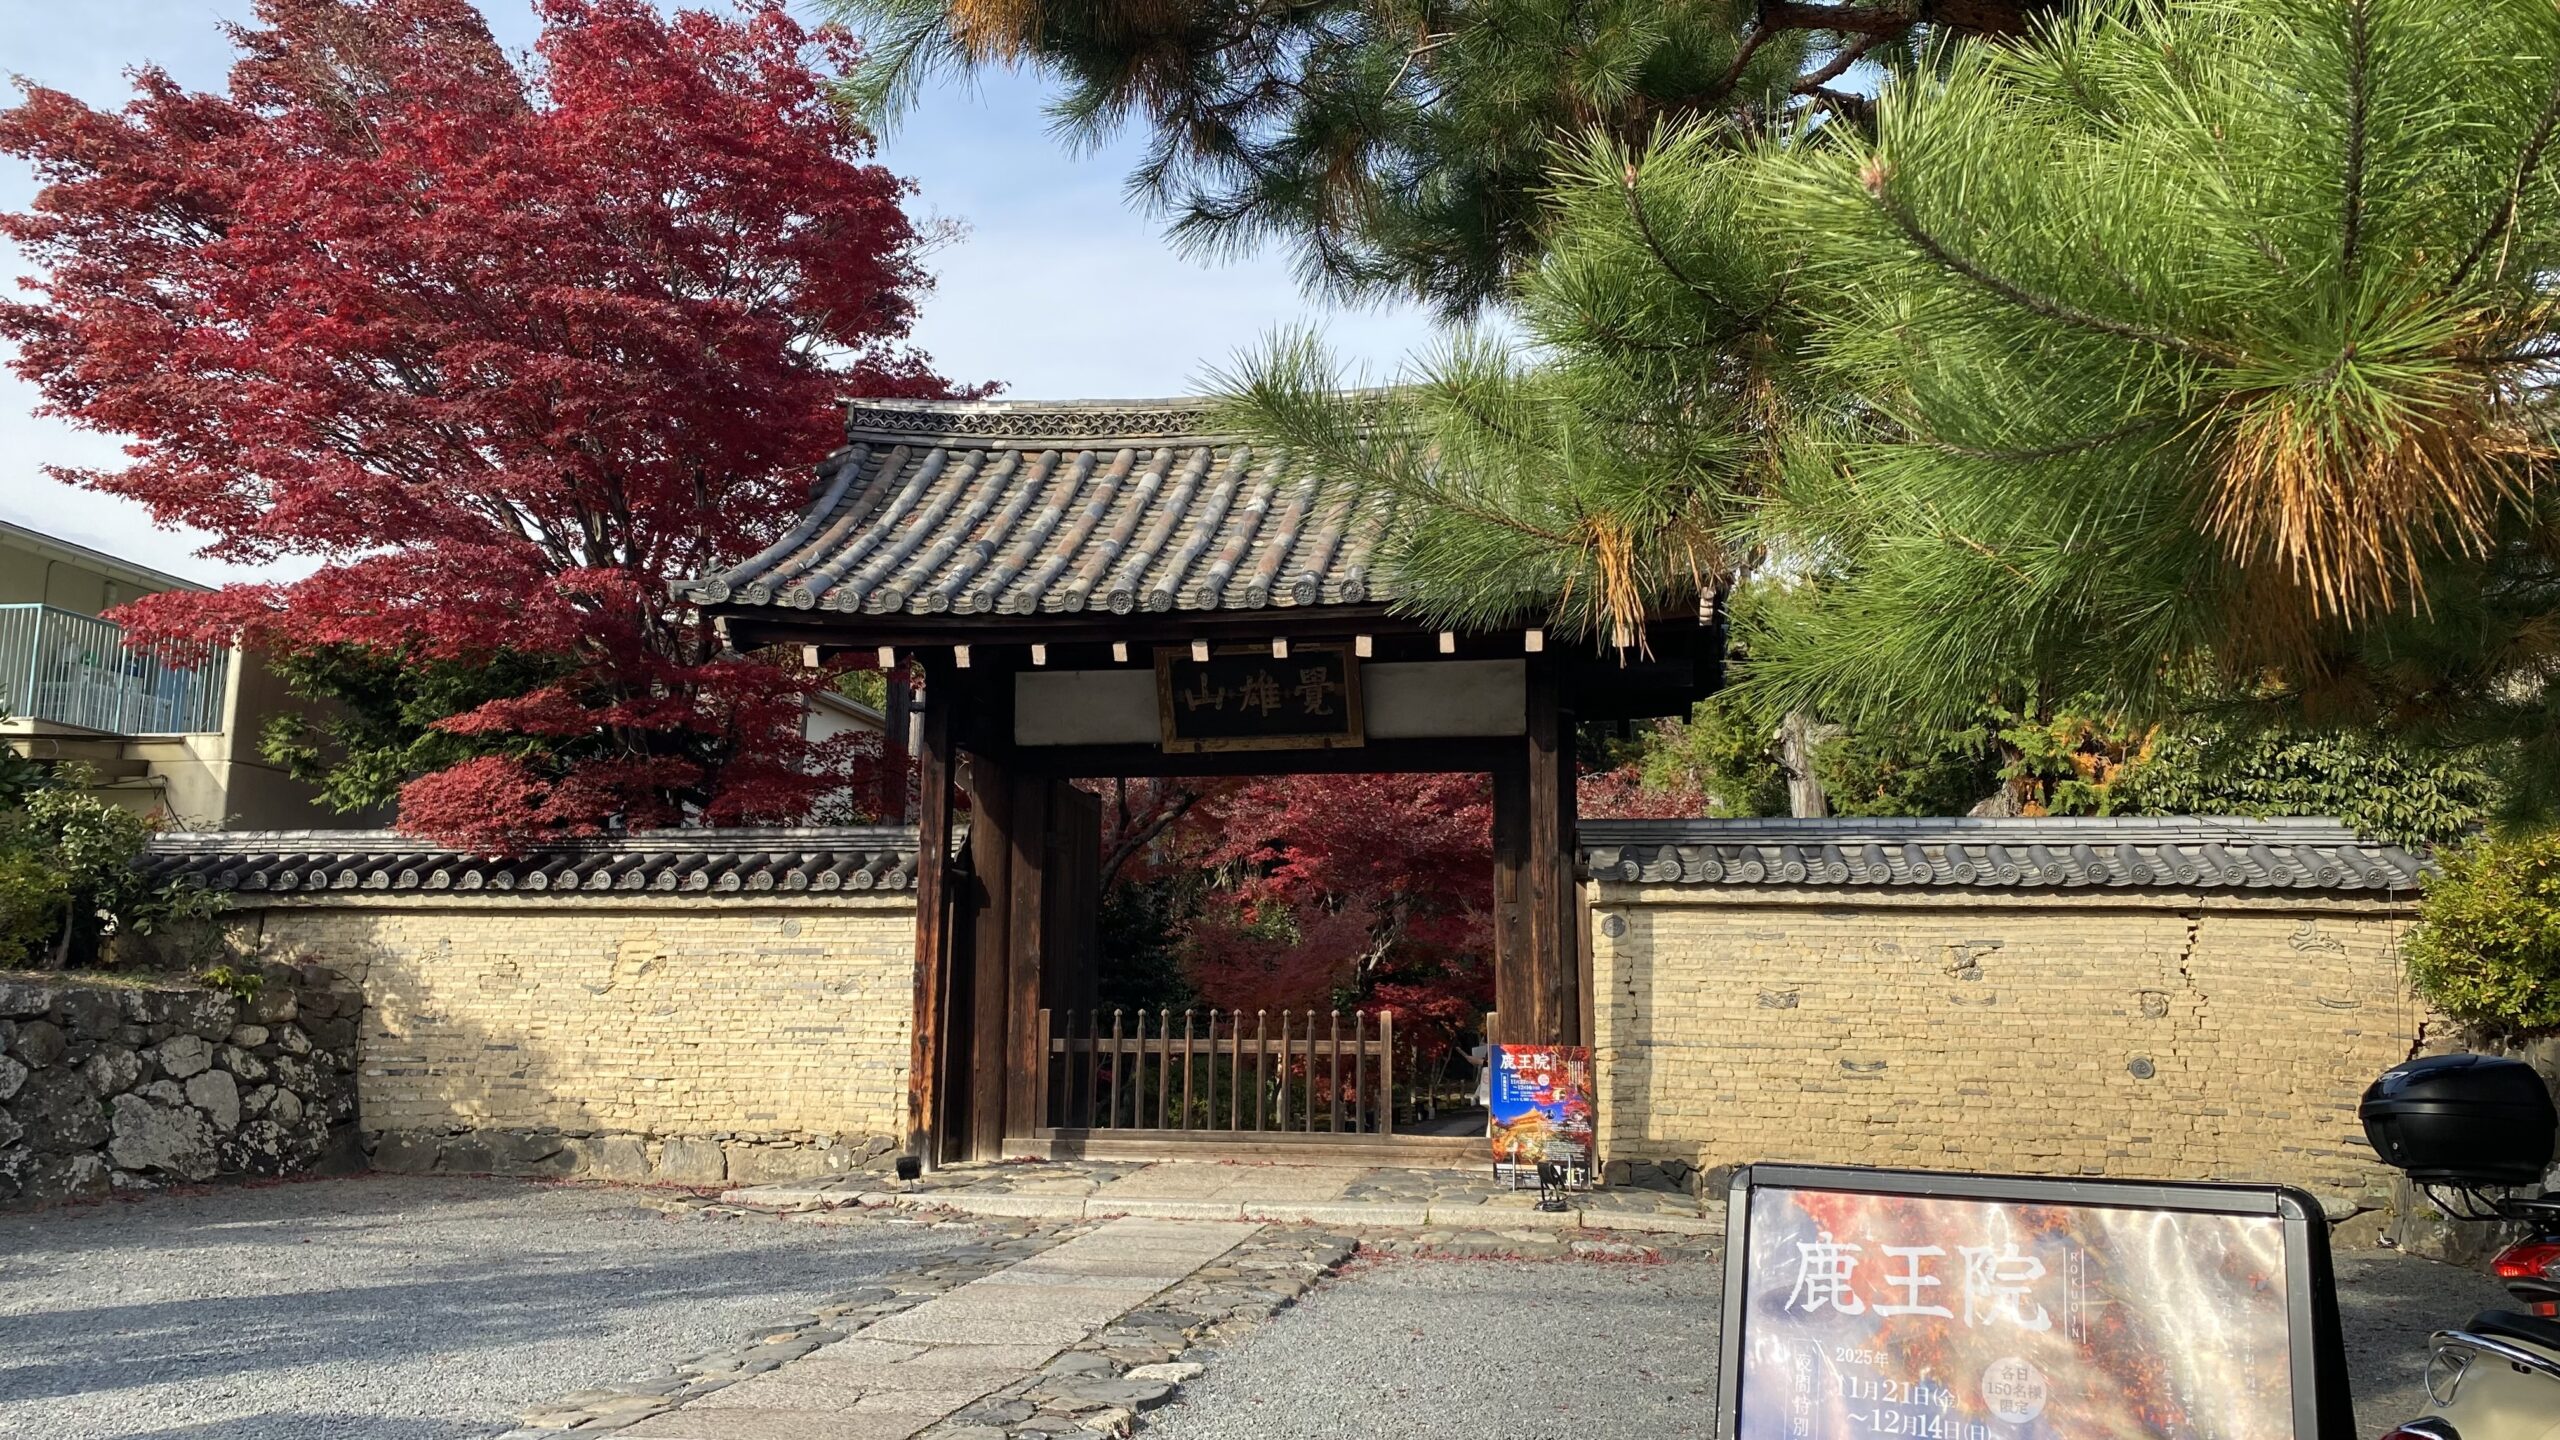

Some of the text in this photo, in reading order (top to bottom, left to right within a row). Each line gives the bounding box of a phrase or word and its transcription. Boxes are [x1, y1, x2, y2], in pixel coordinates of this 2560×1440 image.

[1184, 666, 1335, 717] 覺雄山
[1500, 1053, 1551, 1070] 鹿王院
[1785, 1231, 2052, 1331] 鹿王院
[2070, 1252, 2079, 1338] ROKUOIN
[1836, 1347, 1889, 1368] 2025年
[2001, 1365, 2028, 1382] 各日
[1793, 1353, 1812, 1440] 夜間特別
[1986, 1381, 2042, 1400] 150名様
[2000, 1399, 2028, 1415] 限定
